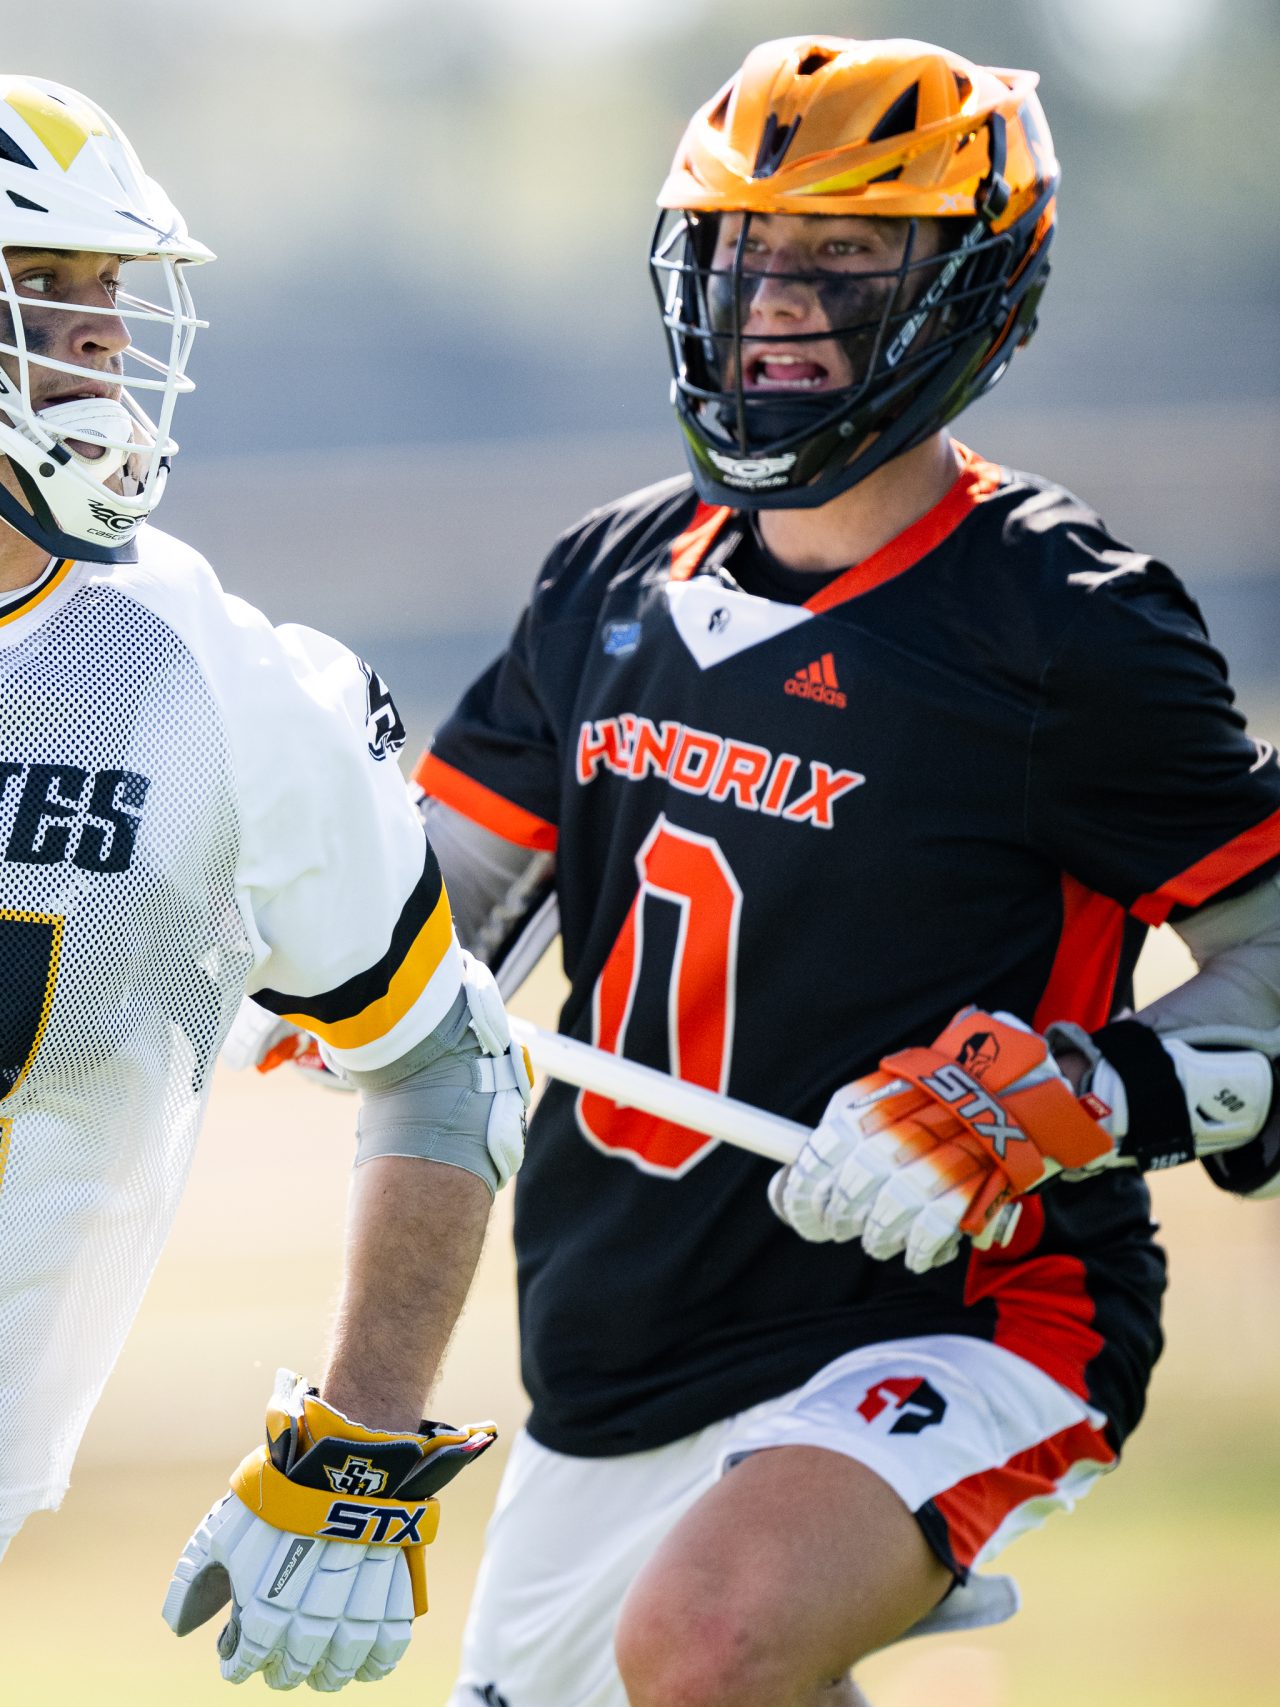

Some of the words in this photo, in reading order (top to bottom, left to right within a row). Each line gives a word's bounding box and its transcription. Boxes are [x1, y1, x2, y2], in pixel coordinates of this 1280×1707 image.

[784, 678, 848, 710] adidas
[918, 1063, 1029, 1162] STX
[314, 1500, 428, 1545] STX
[274, 1544, 304, 1594] SURGEON
